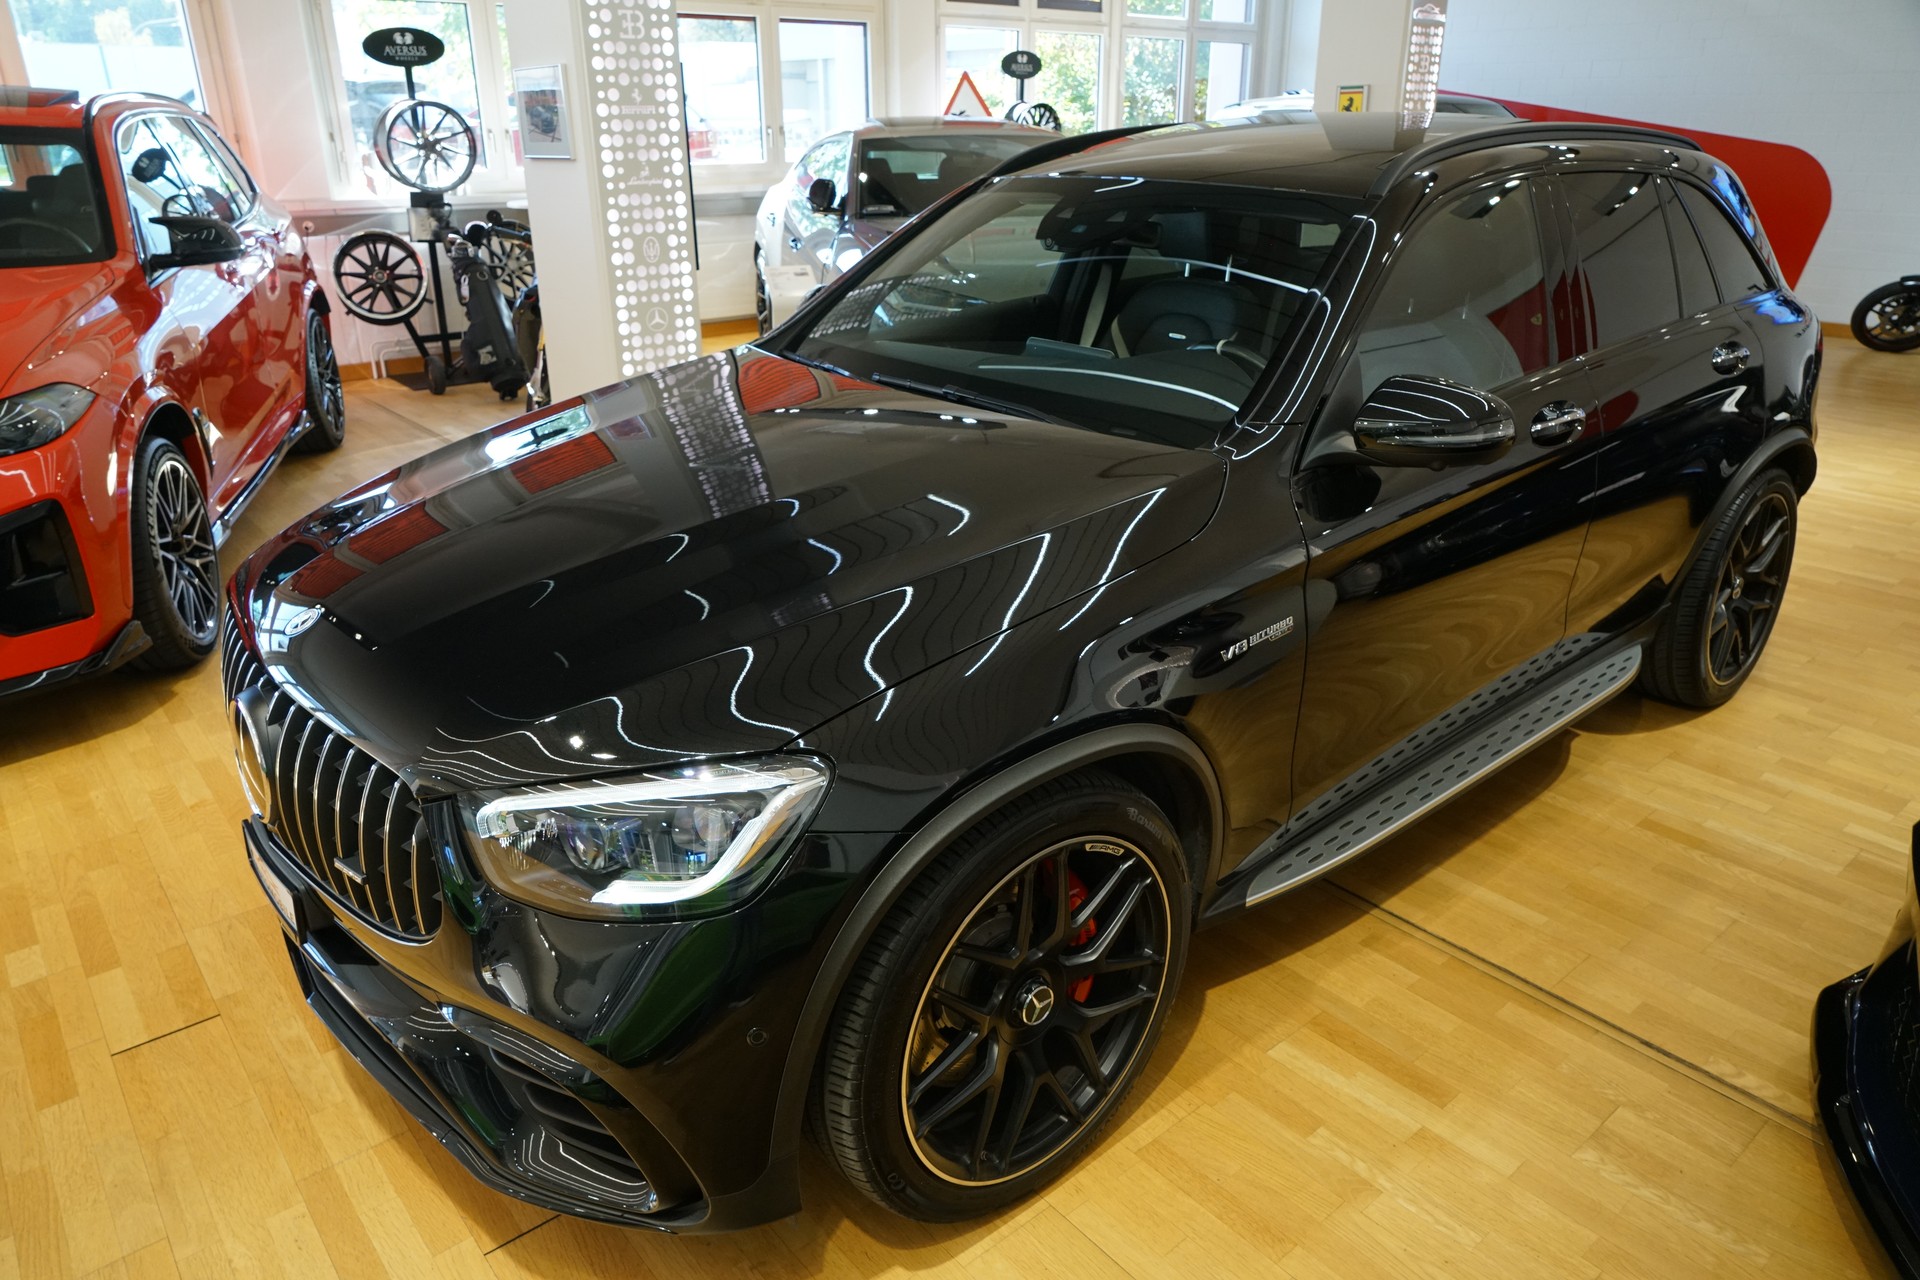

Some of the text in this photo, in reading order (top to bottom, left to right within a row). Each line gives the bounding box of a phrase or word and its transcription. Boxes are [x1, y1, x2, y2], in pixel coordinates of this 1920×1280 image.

[384, 45, 427, 56] AVERSUS
[1220, 616, 1294, 662] V8 BITURBO
[1098, 845, 1121, 855] AMG
